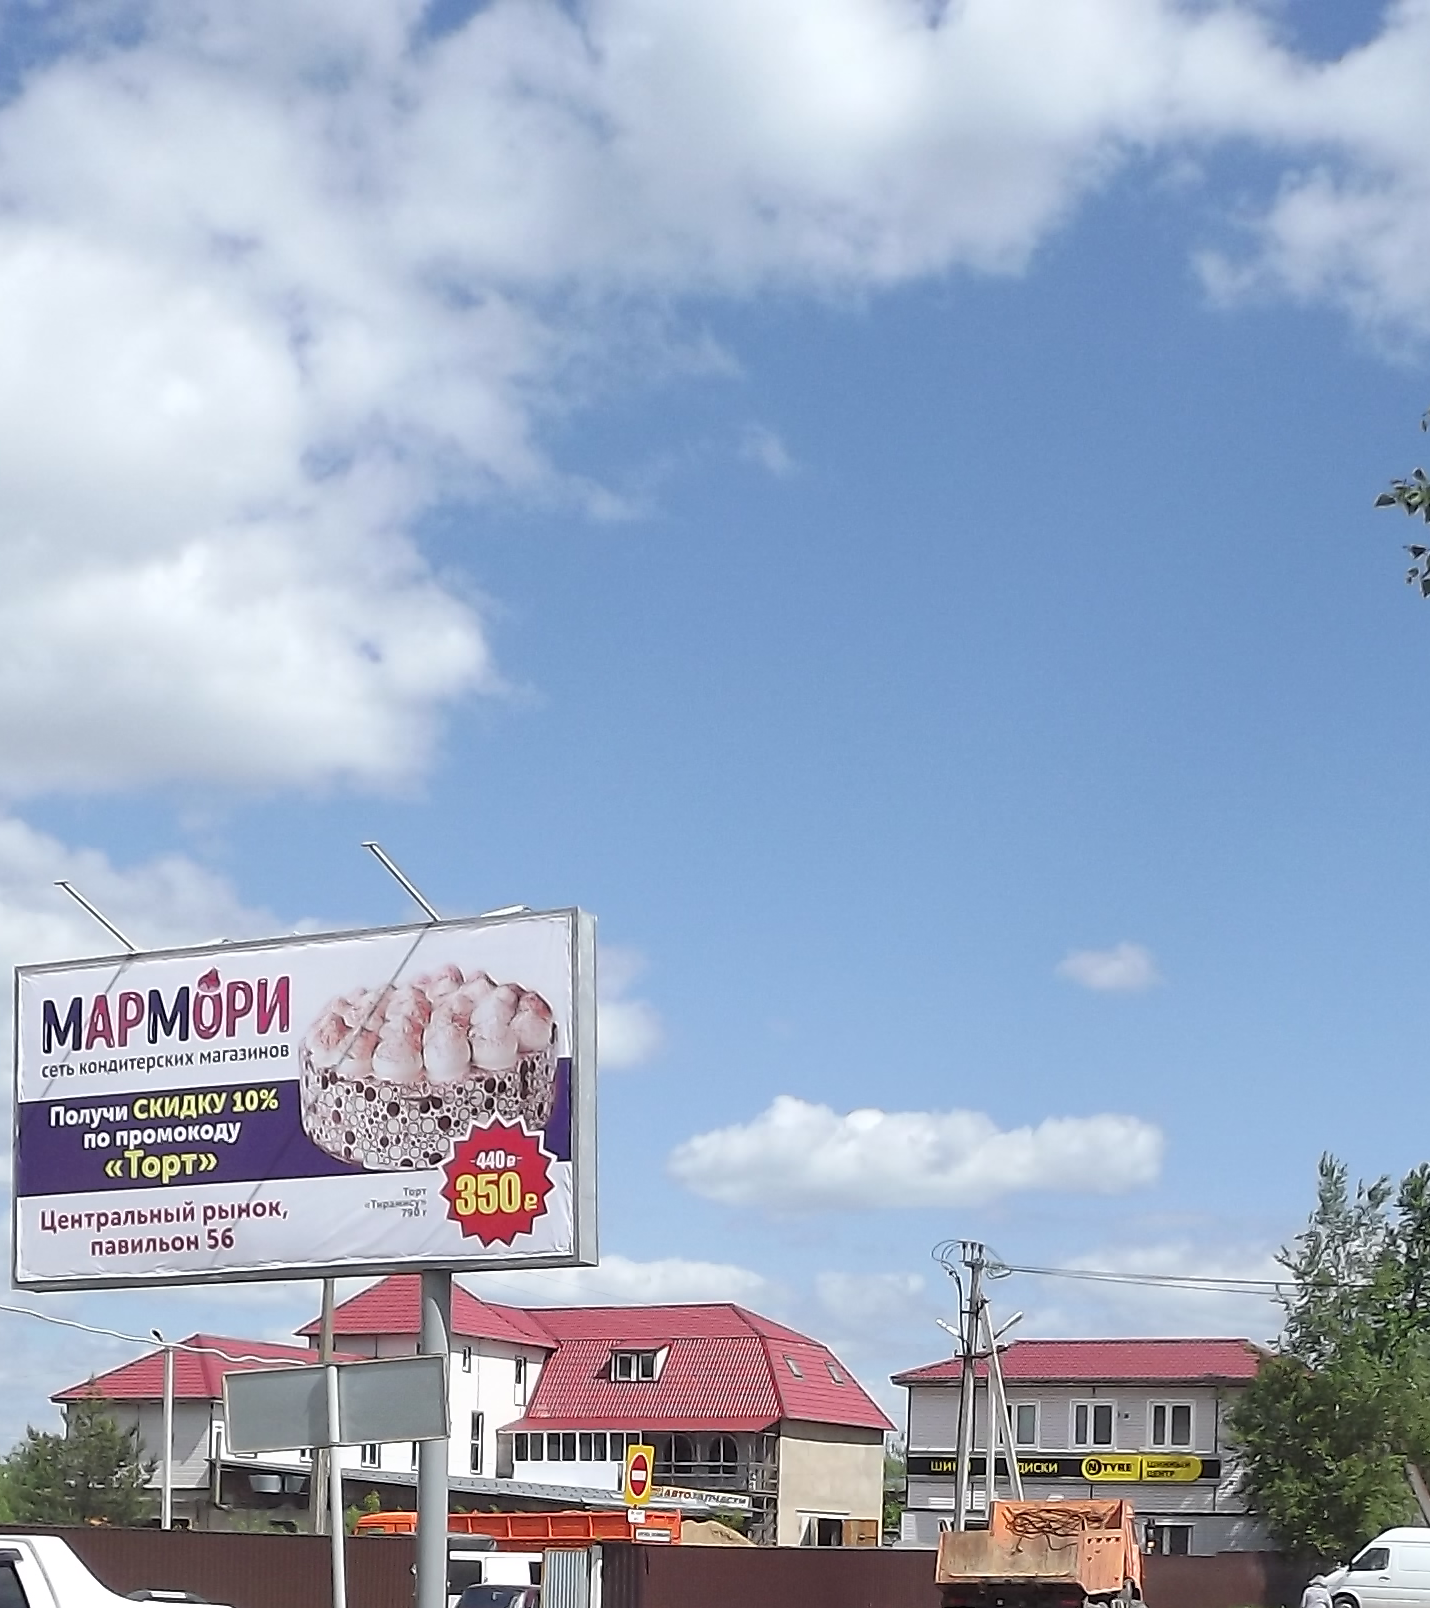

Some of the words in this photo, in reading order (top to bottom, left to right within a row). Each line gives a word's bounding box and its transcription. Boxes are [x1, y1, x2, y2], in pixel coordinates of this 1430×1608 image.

[42, 975, 291, 1054] МАРМОРИ
[41, 1063, 75, 1079] сеть
[78, 1051, 195, 1076] кондитерских
[198, 1043, 290, 1064] магазинов
[50, 1104, 129, 1129] Получи
[132, 1092, 228, 1120] СКИДКУ
[231, 1087, 280, 1113] 10%
[83, 1132, 111, 1149] по
[115, 1121, 242, 1150] промокоду
[103, 1149, 218, 1184] «Торт»
[402, 1187, 428, 1198] Торт
[39, 1201, 196, 1234] Центральный
[201, 1200, 290, 1225] рынок,
[401, 1207, 421, 1217] 790
[90, 1233, 200, 1257] павильон
[206, 1227, 236, 1250] 56
[1101, 1462, 1133, 1473] TYRE
